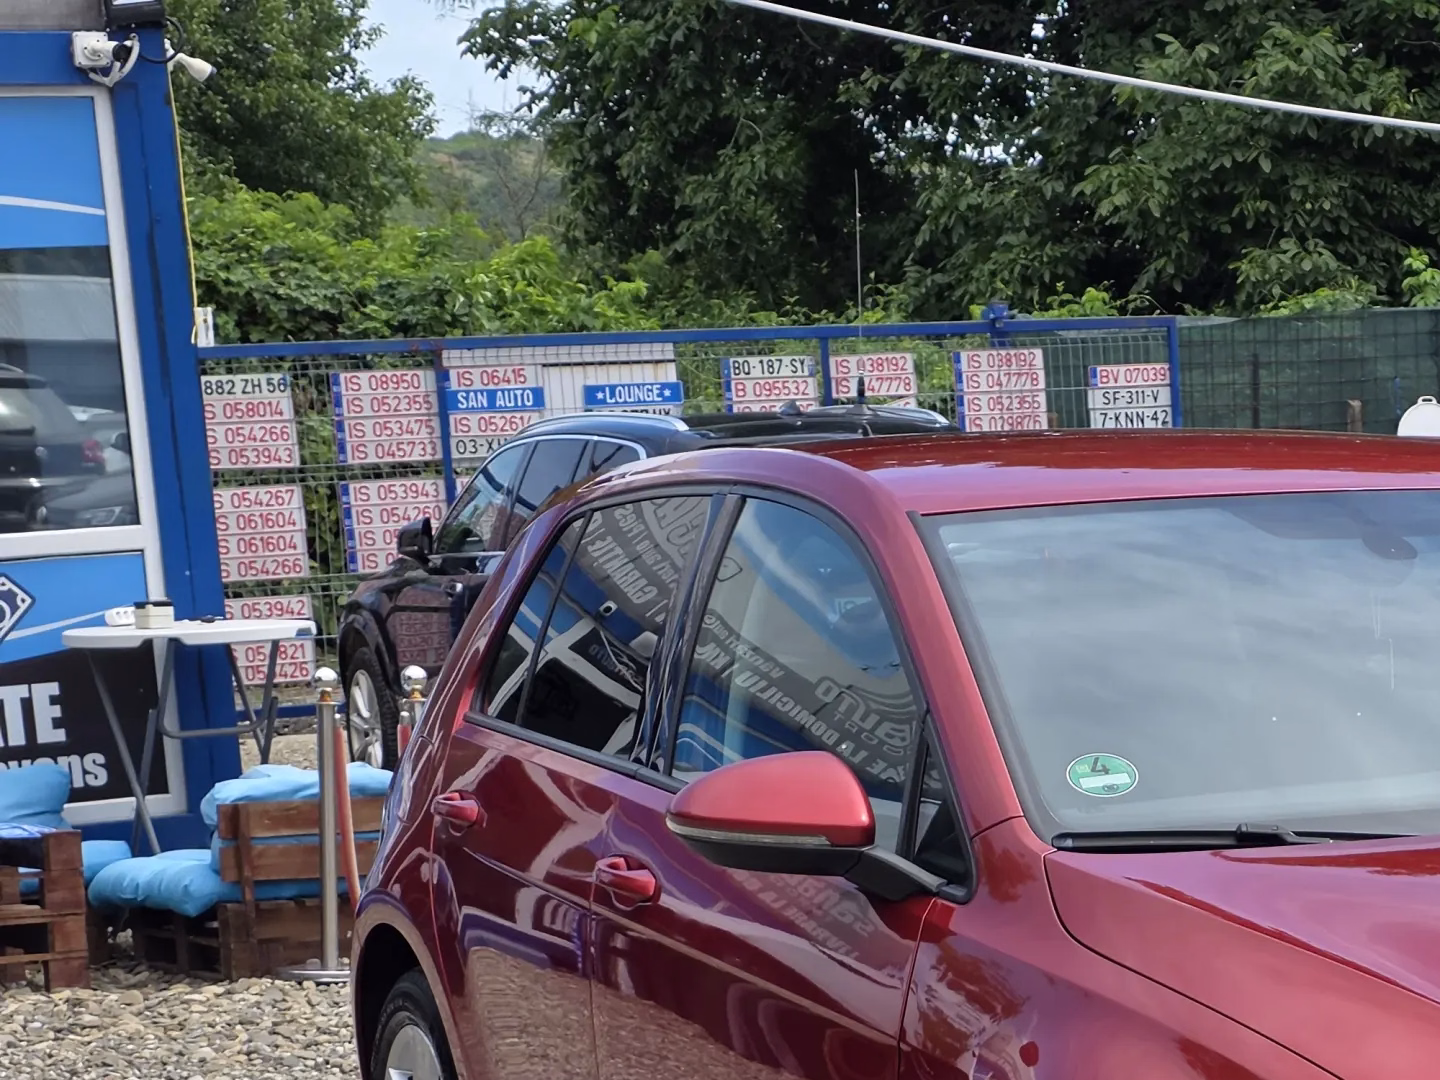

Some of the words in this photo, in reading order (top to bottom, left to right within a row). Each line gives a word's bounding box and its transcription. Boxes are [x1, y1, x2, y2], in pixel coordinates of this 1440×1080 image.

[835, 359, 851, 375] IS
[967, 354, 982, 369] IS
[986, 352, 1036, 368] 038192
[203, 380, 236, 395] 882
[240, 378, 262, 394] ZH
[266, 377, 288, 393] 56
[344, 375, 362, 392] IS
[368, 373, 421, 391] 08950
[457, 370, 474, 388] IS
[480, 368, 527, 387] 06415
[835, 378, 851, 395] IS
[861, 376, 912, 393] 47778
[966, 374, 981, 390] IS
[986, 372, 1039, 389] 047778
[1099, 369, 1120, 384] BV
[605, 384, 663, 403] LOUNGE
[734, 382, 746, 398] B
[753, 380, 809, 397] 095532
[1102, 389, 1160, 405] SF-311-V
[346, 397, 364, 414] IS
[370, 394, 433, 413] 052355
[457, 391, 488, 409] SAN
[496, 390, 533, 407] AUTO
[968, 397, 982, 413] IS
[987, 395, 1041, 411] 052355
[222, 400, 284, 419] 058014
[1100, 410, 1169, 428] 7-KNN-42
[224, 425, 290, 444] 054266
[348, 422, 366, 439] IS
[372, 419, 435, 437] 053475
[454, 417, 471, 434] IS
[228, 447, 293, 465] 053943
[351, 443, 368, 460] IS
[374, 440, 437, 459] 045733
[230, 489, 295, 509] 054267
[353, 485, 371, 502] IS
[377, 482, 440, 501] 053943
[236, 510, 296, 530] 061604
[355, 508, 373, 525] IS
[237, 534, 297, 554] 061604
[358, 530, 376, 547] IS
[237, 558, 303, 577] 054266
[361, 553, 379, 570] IS
[241, 599, 306, 619] 053942
[245, 643, 306, 663] 05821
[245, 662, 310, 681] 05426
[0, 682, 66, 748] TE
